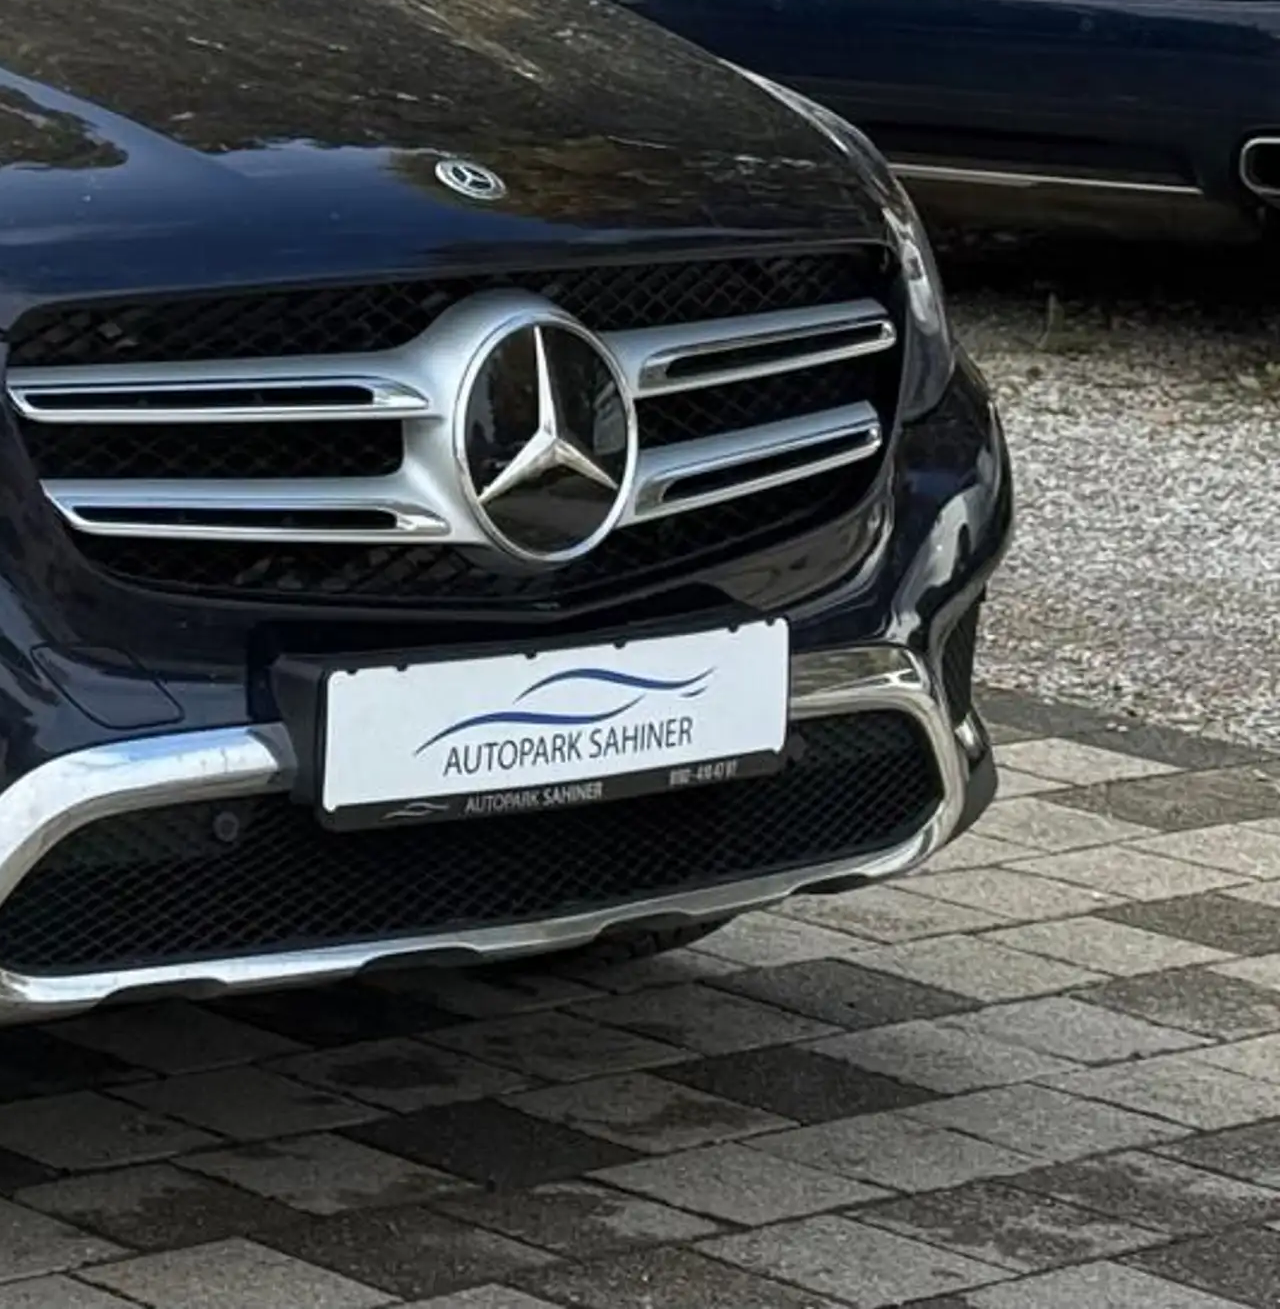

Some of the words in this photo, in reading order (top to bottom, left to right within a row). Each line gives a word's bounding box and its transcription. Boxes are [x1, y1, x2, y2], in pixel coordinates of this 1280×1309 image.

[443, 730, 582, 777] AUTOPARK
[588, 716, 694, 760] SAHINER
[466, 788, 539, 815] AUTOPARK
[543, 781, 604, 806] SAHINER
